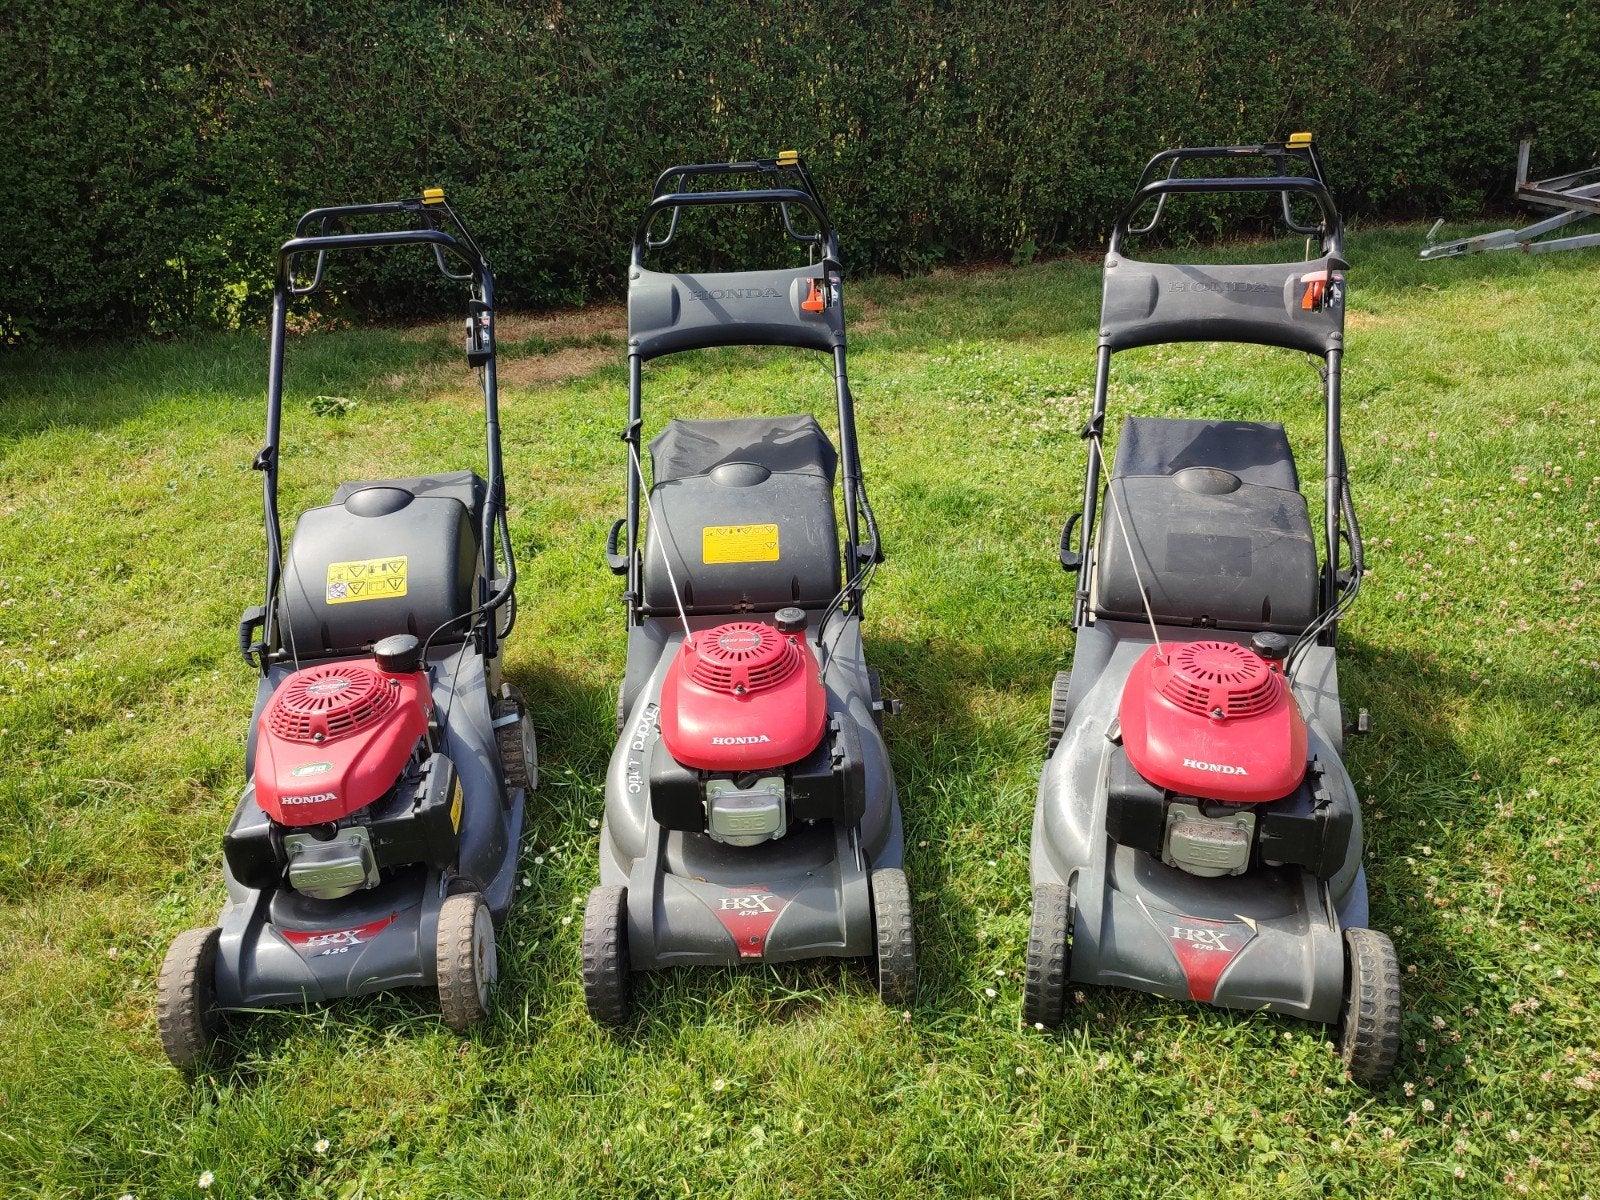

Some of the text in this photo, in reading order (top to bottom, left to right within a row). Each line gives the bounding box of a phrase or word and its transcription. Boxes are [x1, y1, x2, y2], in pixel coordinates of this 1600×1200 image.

[1168, 280, 1277, 294] HONDA
[688, 287, 783, 302] HONDA
[711, 735, 771, 745] HONDA
[1183, 758, 1248, 775] HONDA
[281, 792, 338, 805] HONDA
[718, 895, 775, 913] HRX
[739, 909, 758, 917] 476
[305, 928, 368, 947] HRX
[1170, 926, 1233, 952] HRX
[321, 946, 349, 956] 426
[1191, 943, 1214, 952] 476
